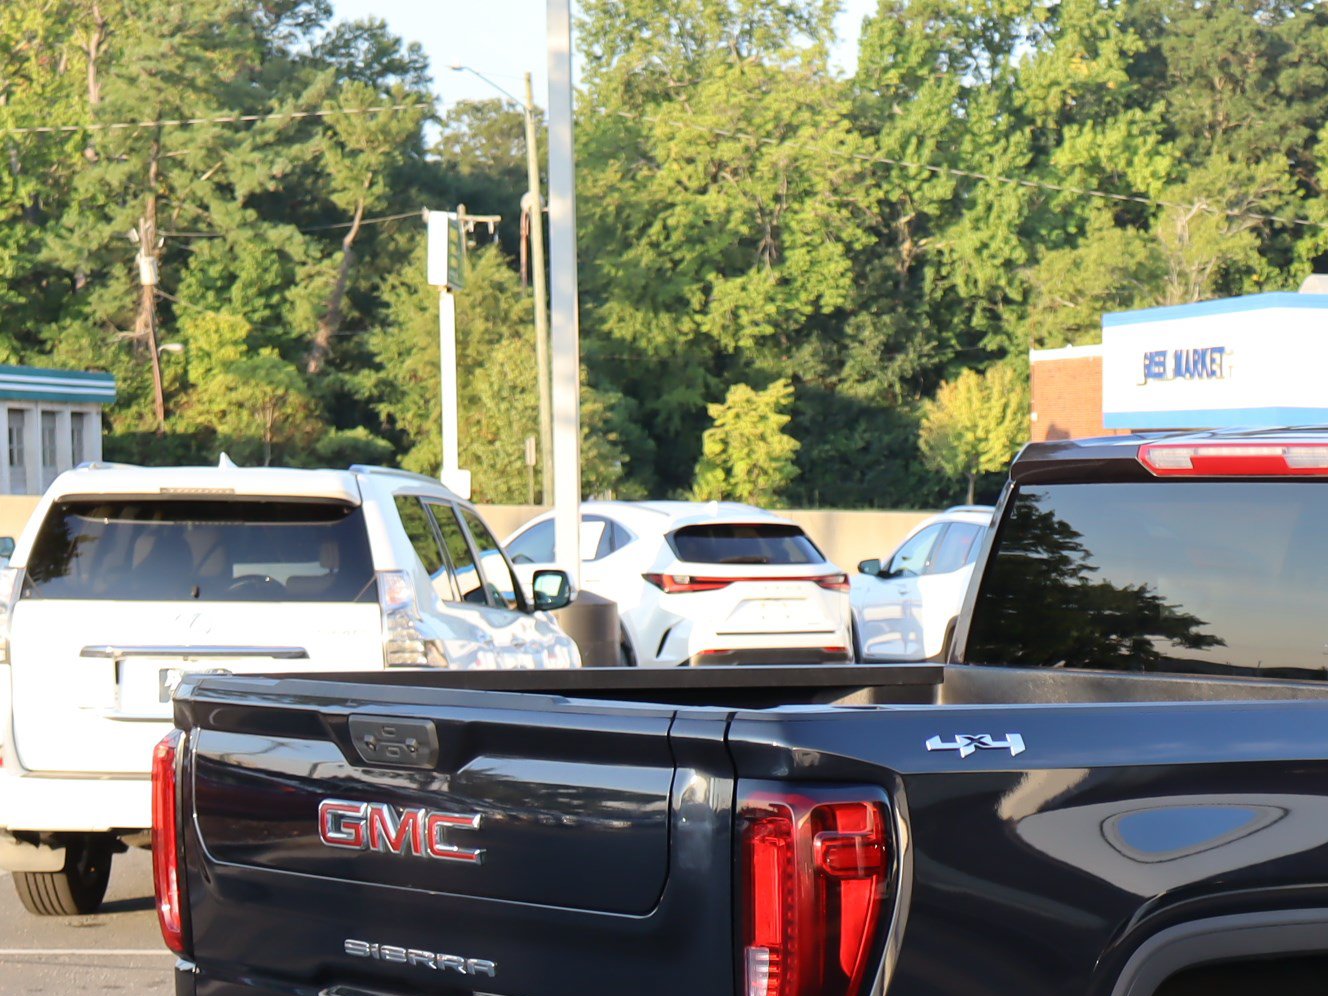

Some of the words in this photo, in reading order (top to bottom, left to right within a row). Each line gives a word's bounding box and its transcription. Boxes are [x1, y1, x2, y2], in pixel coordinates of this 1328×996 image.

[1174, 346, 1226, 380] MARKET
[318, 798, 486, 865] GMC
[344, 938, 497, 977] SIERRA
